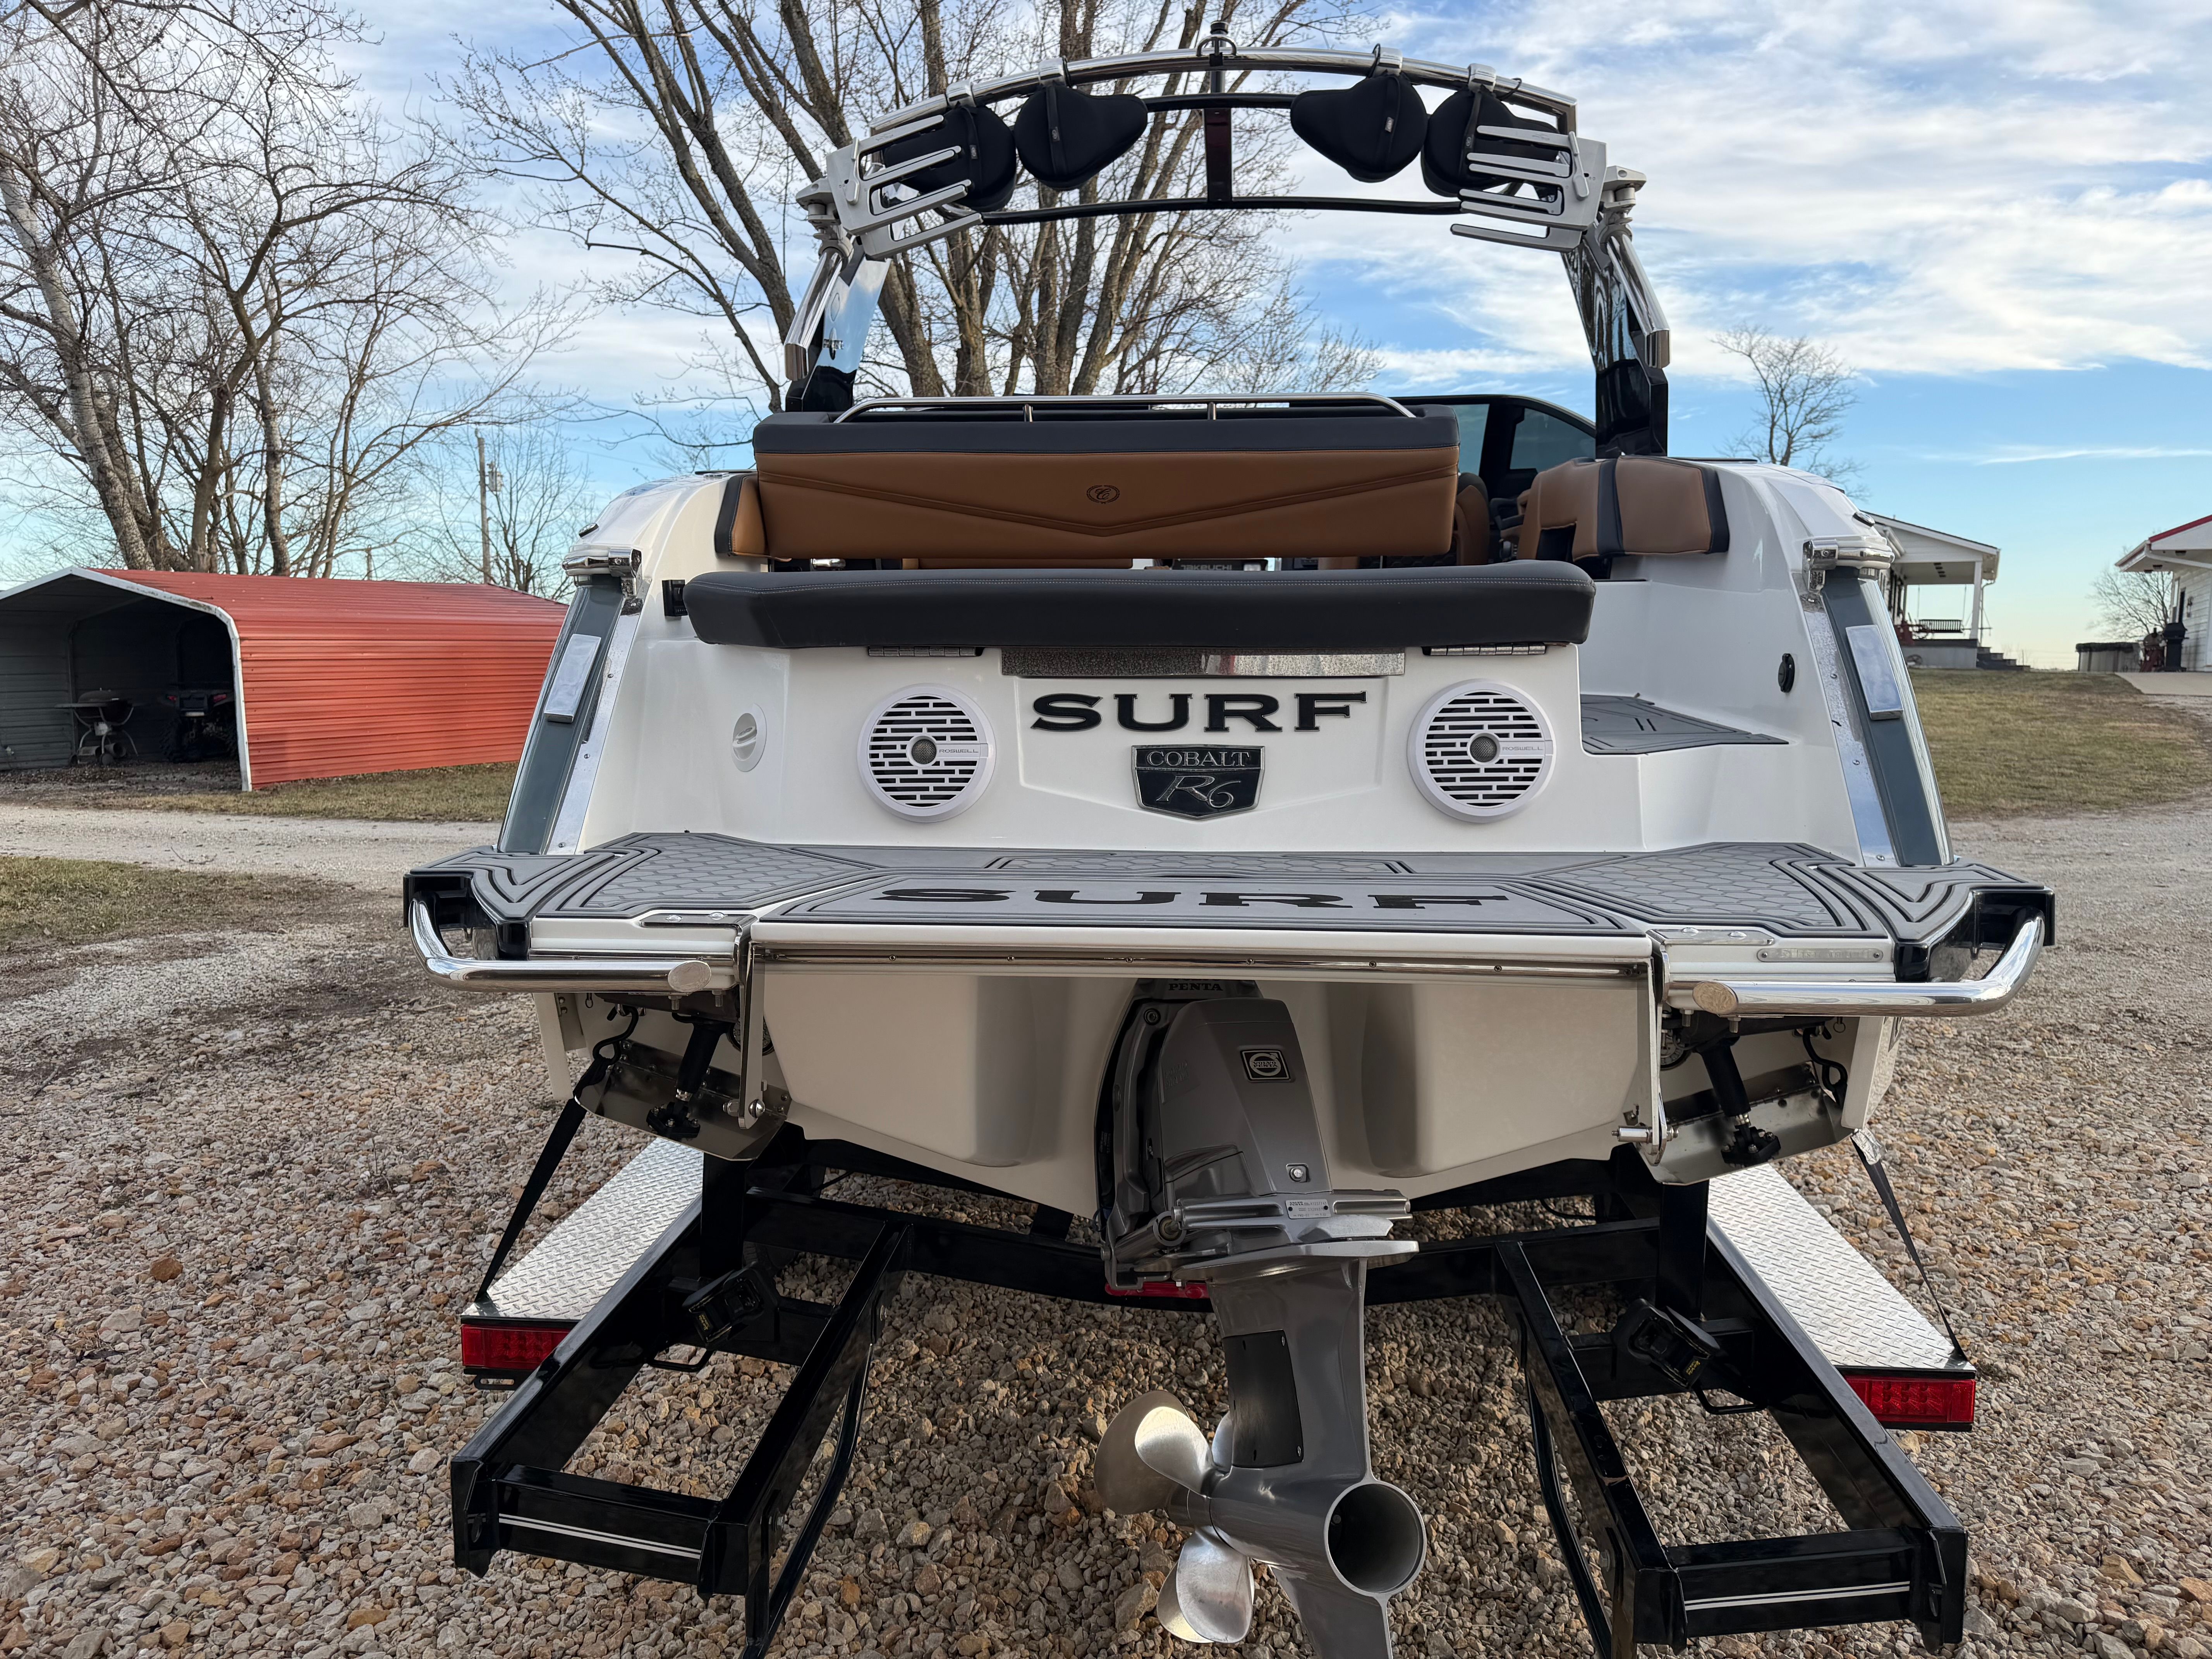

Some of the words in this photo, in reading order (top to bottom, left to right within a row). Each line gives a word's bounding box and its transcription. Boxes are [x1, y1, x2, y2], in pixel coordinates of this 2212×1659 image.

[1030, 691, 1368, 732] SURF
[1147, 751, 1249, 766] COBALT
[1156, 775, 1241, 808] R6
[869, 888, 1510, 908] SURF
